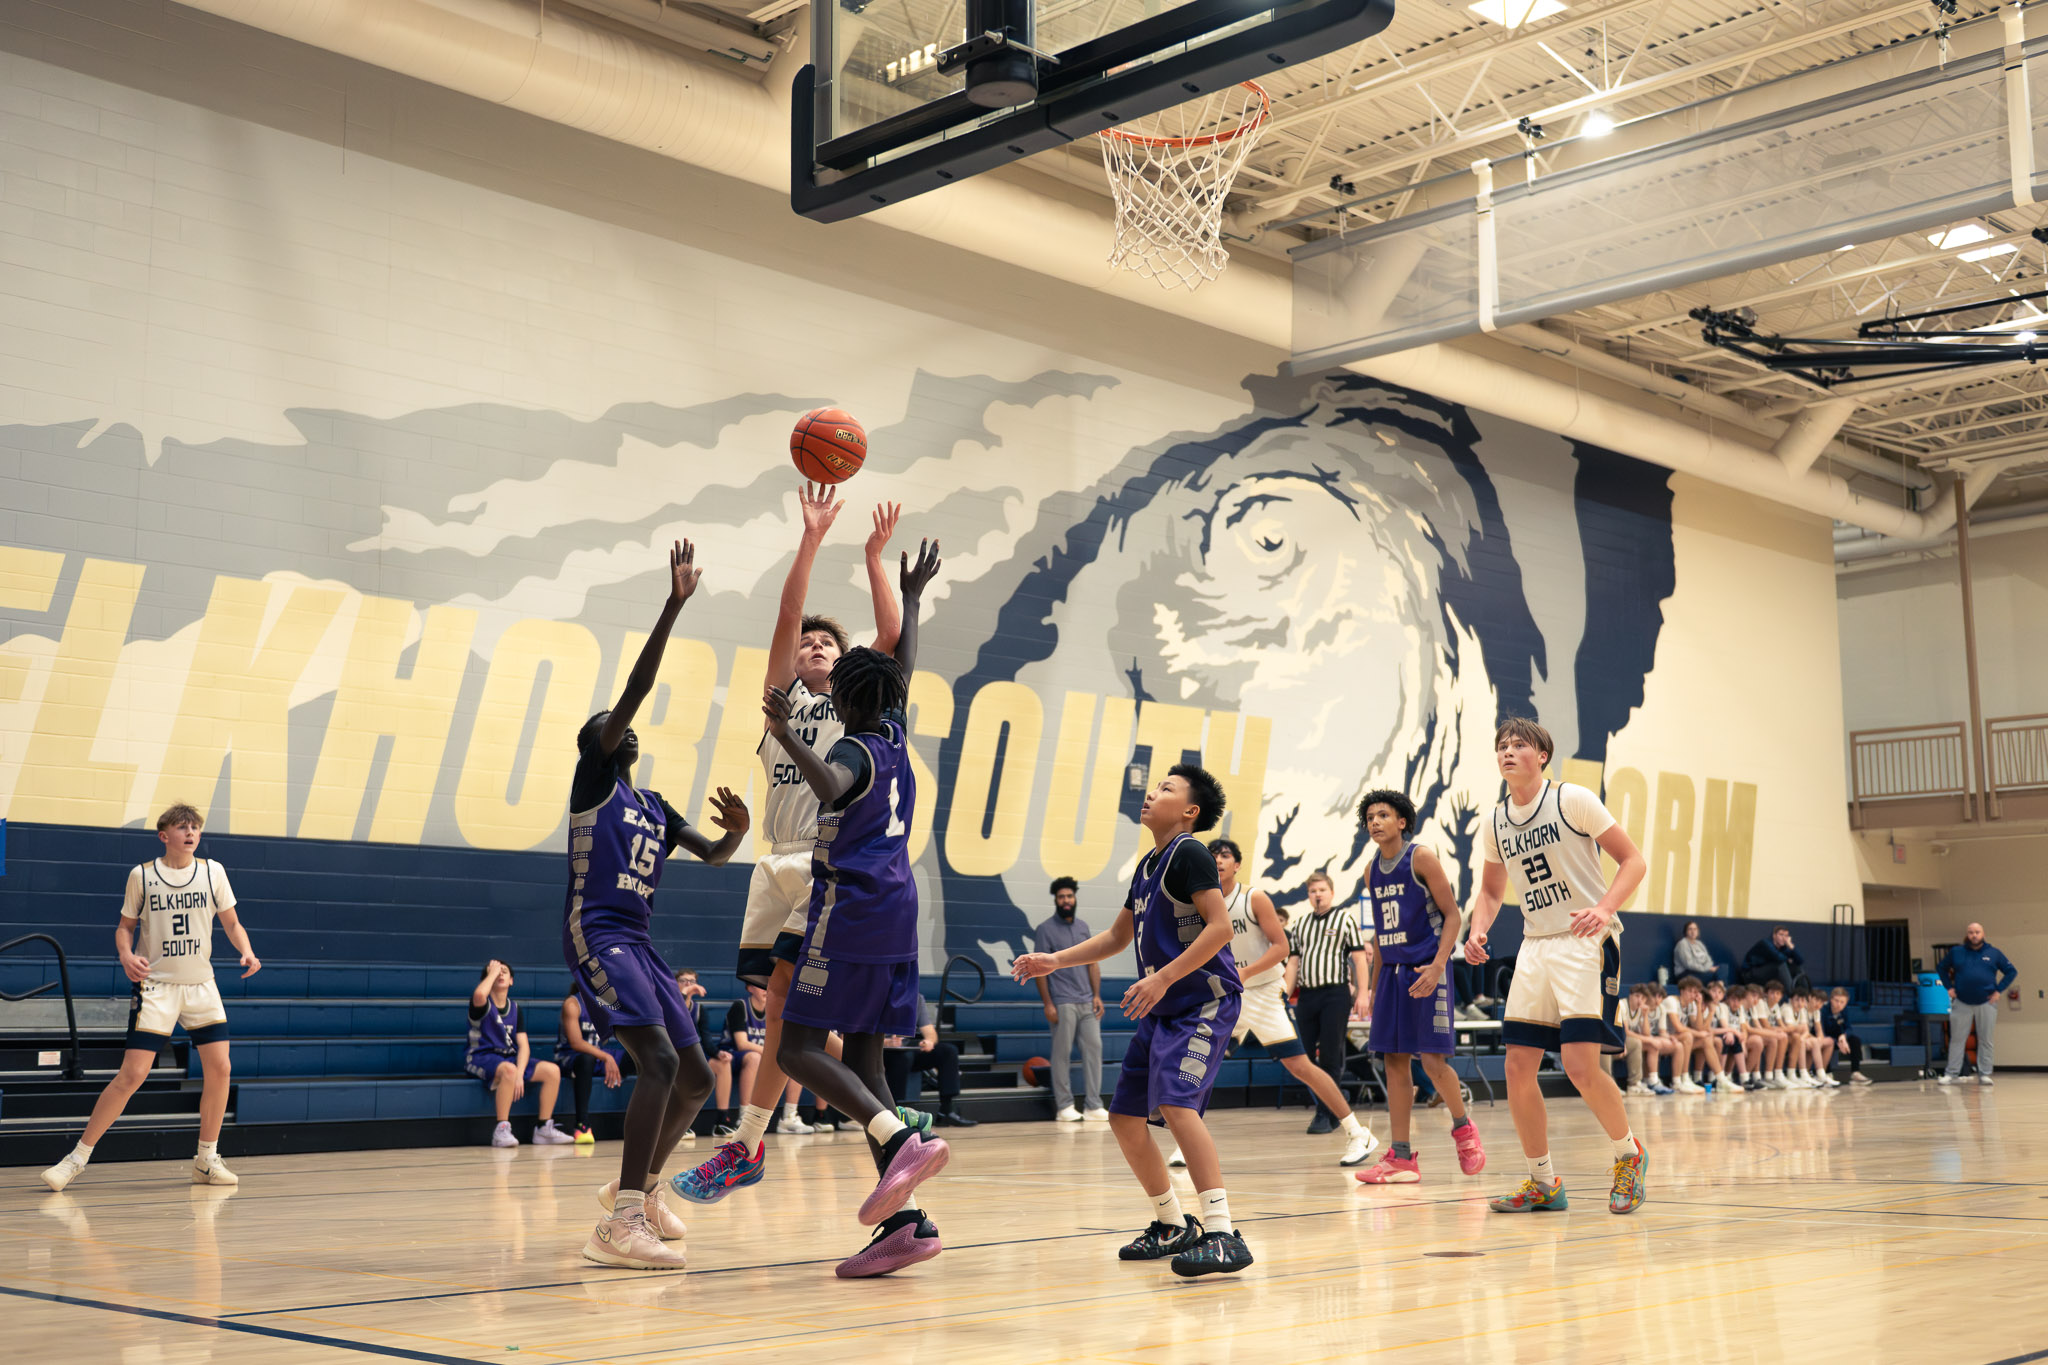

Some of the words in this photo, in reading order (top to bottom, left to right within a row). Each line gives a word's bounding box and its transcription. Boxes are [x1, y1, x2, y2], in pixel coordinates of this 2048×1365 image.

[0, 545, 768, 864] LKHOR
[1502, 757, 1757, 918] ORM
[886, 777, 905, 838] 1
[629, 833, 660, 877] 15
[1502, 821, 1561, 859] ELKHORN
[1521, 852, 1553, 885] 23
[150, 892, 208, 911] ELKHORN
[1374, 883, 1405, 899] EAST
[1524, 880, 1572, 912] SOUTH
[172, 913, 190, 935] 21
[1381, 900, 1399, 930] 20
[162, 938, 201, 957] SOUTH
[1378, 931, 1407, 946] HIGH
